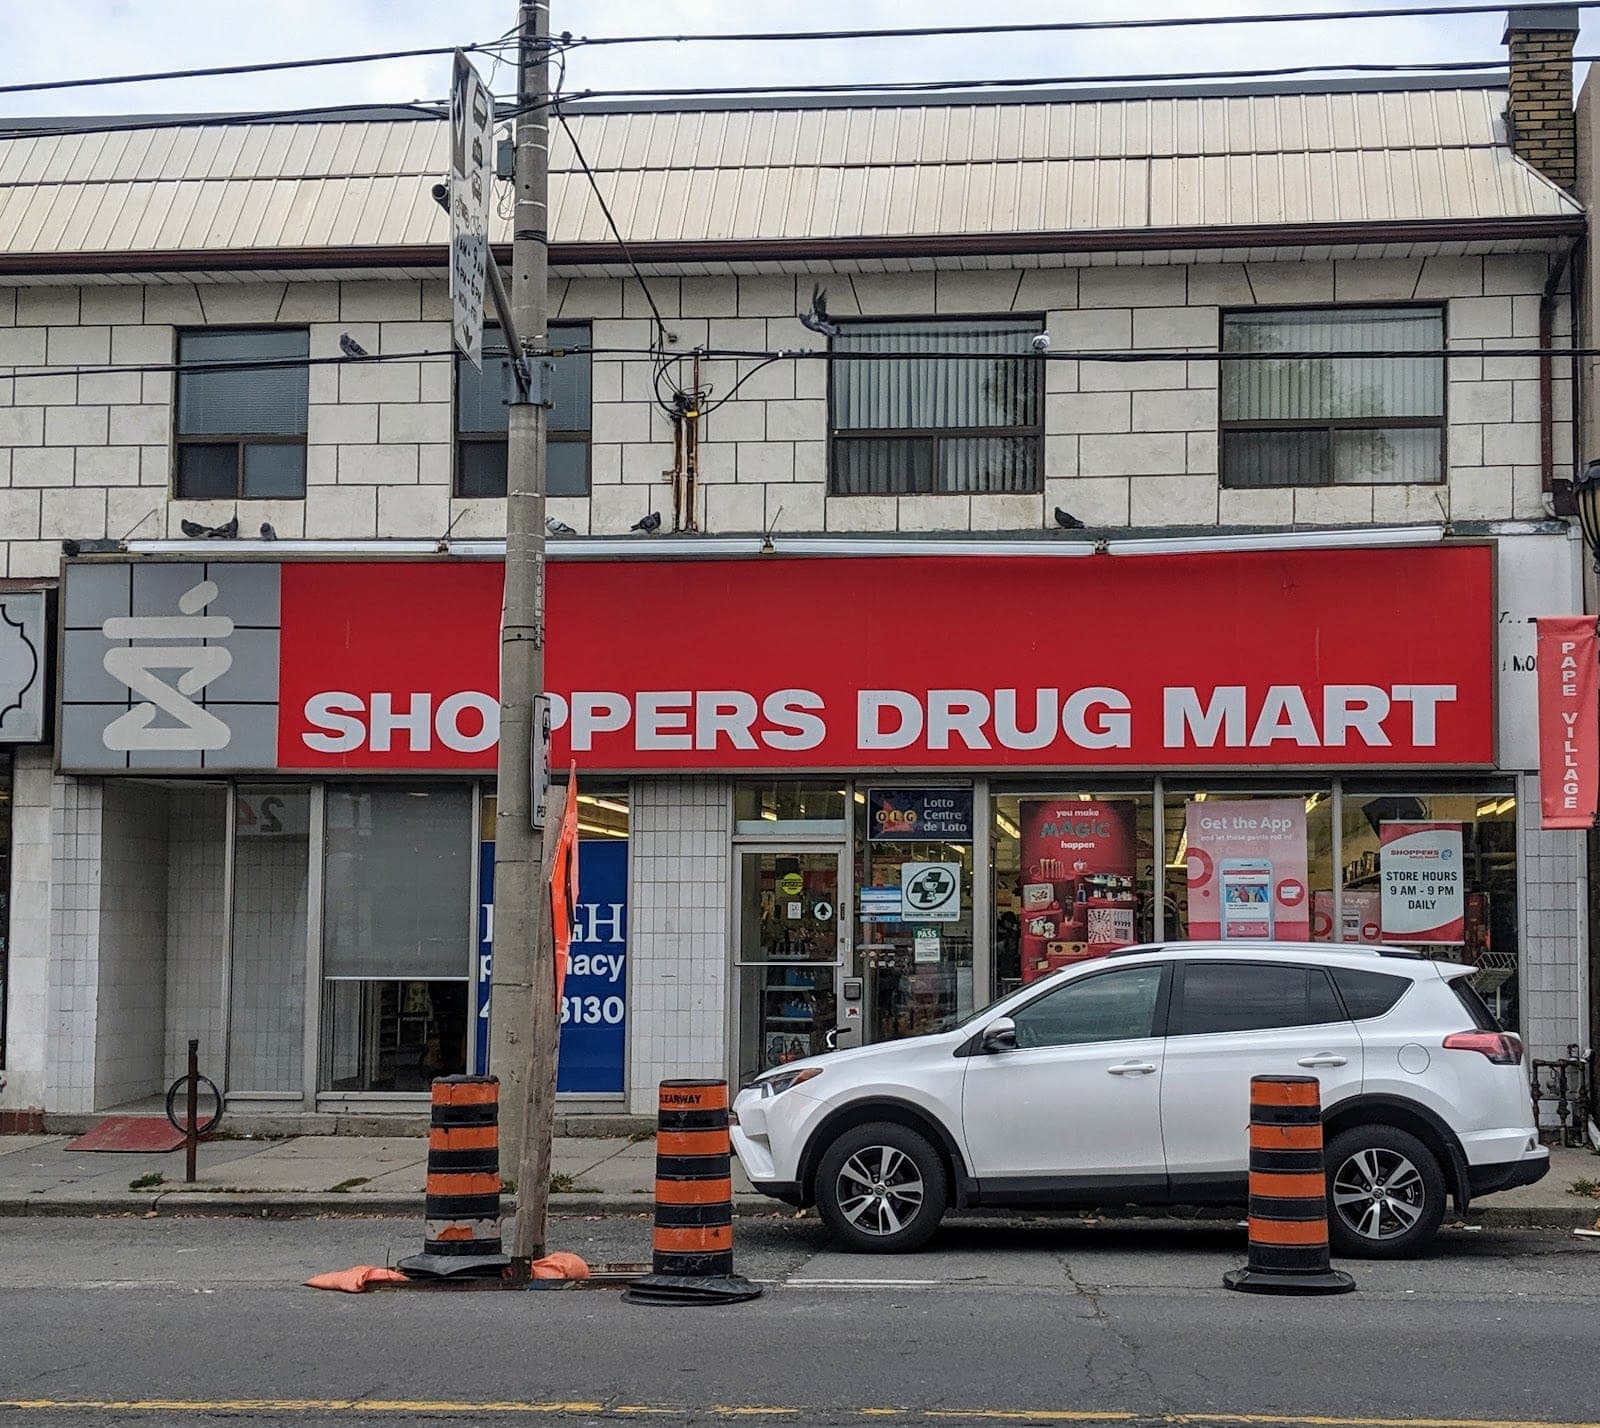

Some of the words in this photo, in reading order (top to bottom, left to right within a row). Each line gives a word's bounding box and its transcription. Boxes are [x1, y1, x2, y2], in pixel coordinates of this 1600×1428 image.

[1561, 642, 1577, 696] PAPE
[856, 686, 1133, 751] DRUG
[1162, 683, 1458, 749] MART
[1561, 712, 1579, 809] VILLAGE
[923, 798, 955, 808] Lotto
[876, 810, 917, 824] OLG
[923, 810, 962, 820] Centre
[1056, 809, 1073, 818] you
[1074, 808, 1100, 817] make
[923, 822, 937, 832] de
[941, 822, 968, 832] Loto
[1200, 817, 1229, 830] Get
[1232, 816, 1258, 830] the
[1260, 816, 1293, 833] App
[1061, 840, 1095, 851] happen
[1386, 871, 1419, 882] STORE
[1422, 871, 1458, 882] HOURS
[1390, 885, 1397, 896] 9
[1400, 885, 1417, 896] AM
[1427, 885, 1434, 896] 9
[1438, 885, 1454, 895] PM
[1408, 900, 1437, 910] DAILY
[917, 930, 937, 938] PASS
